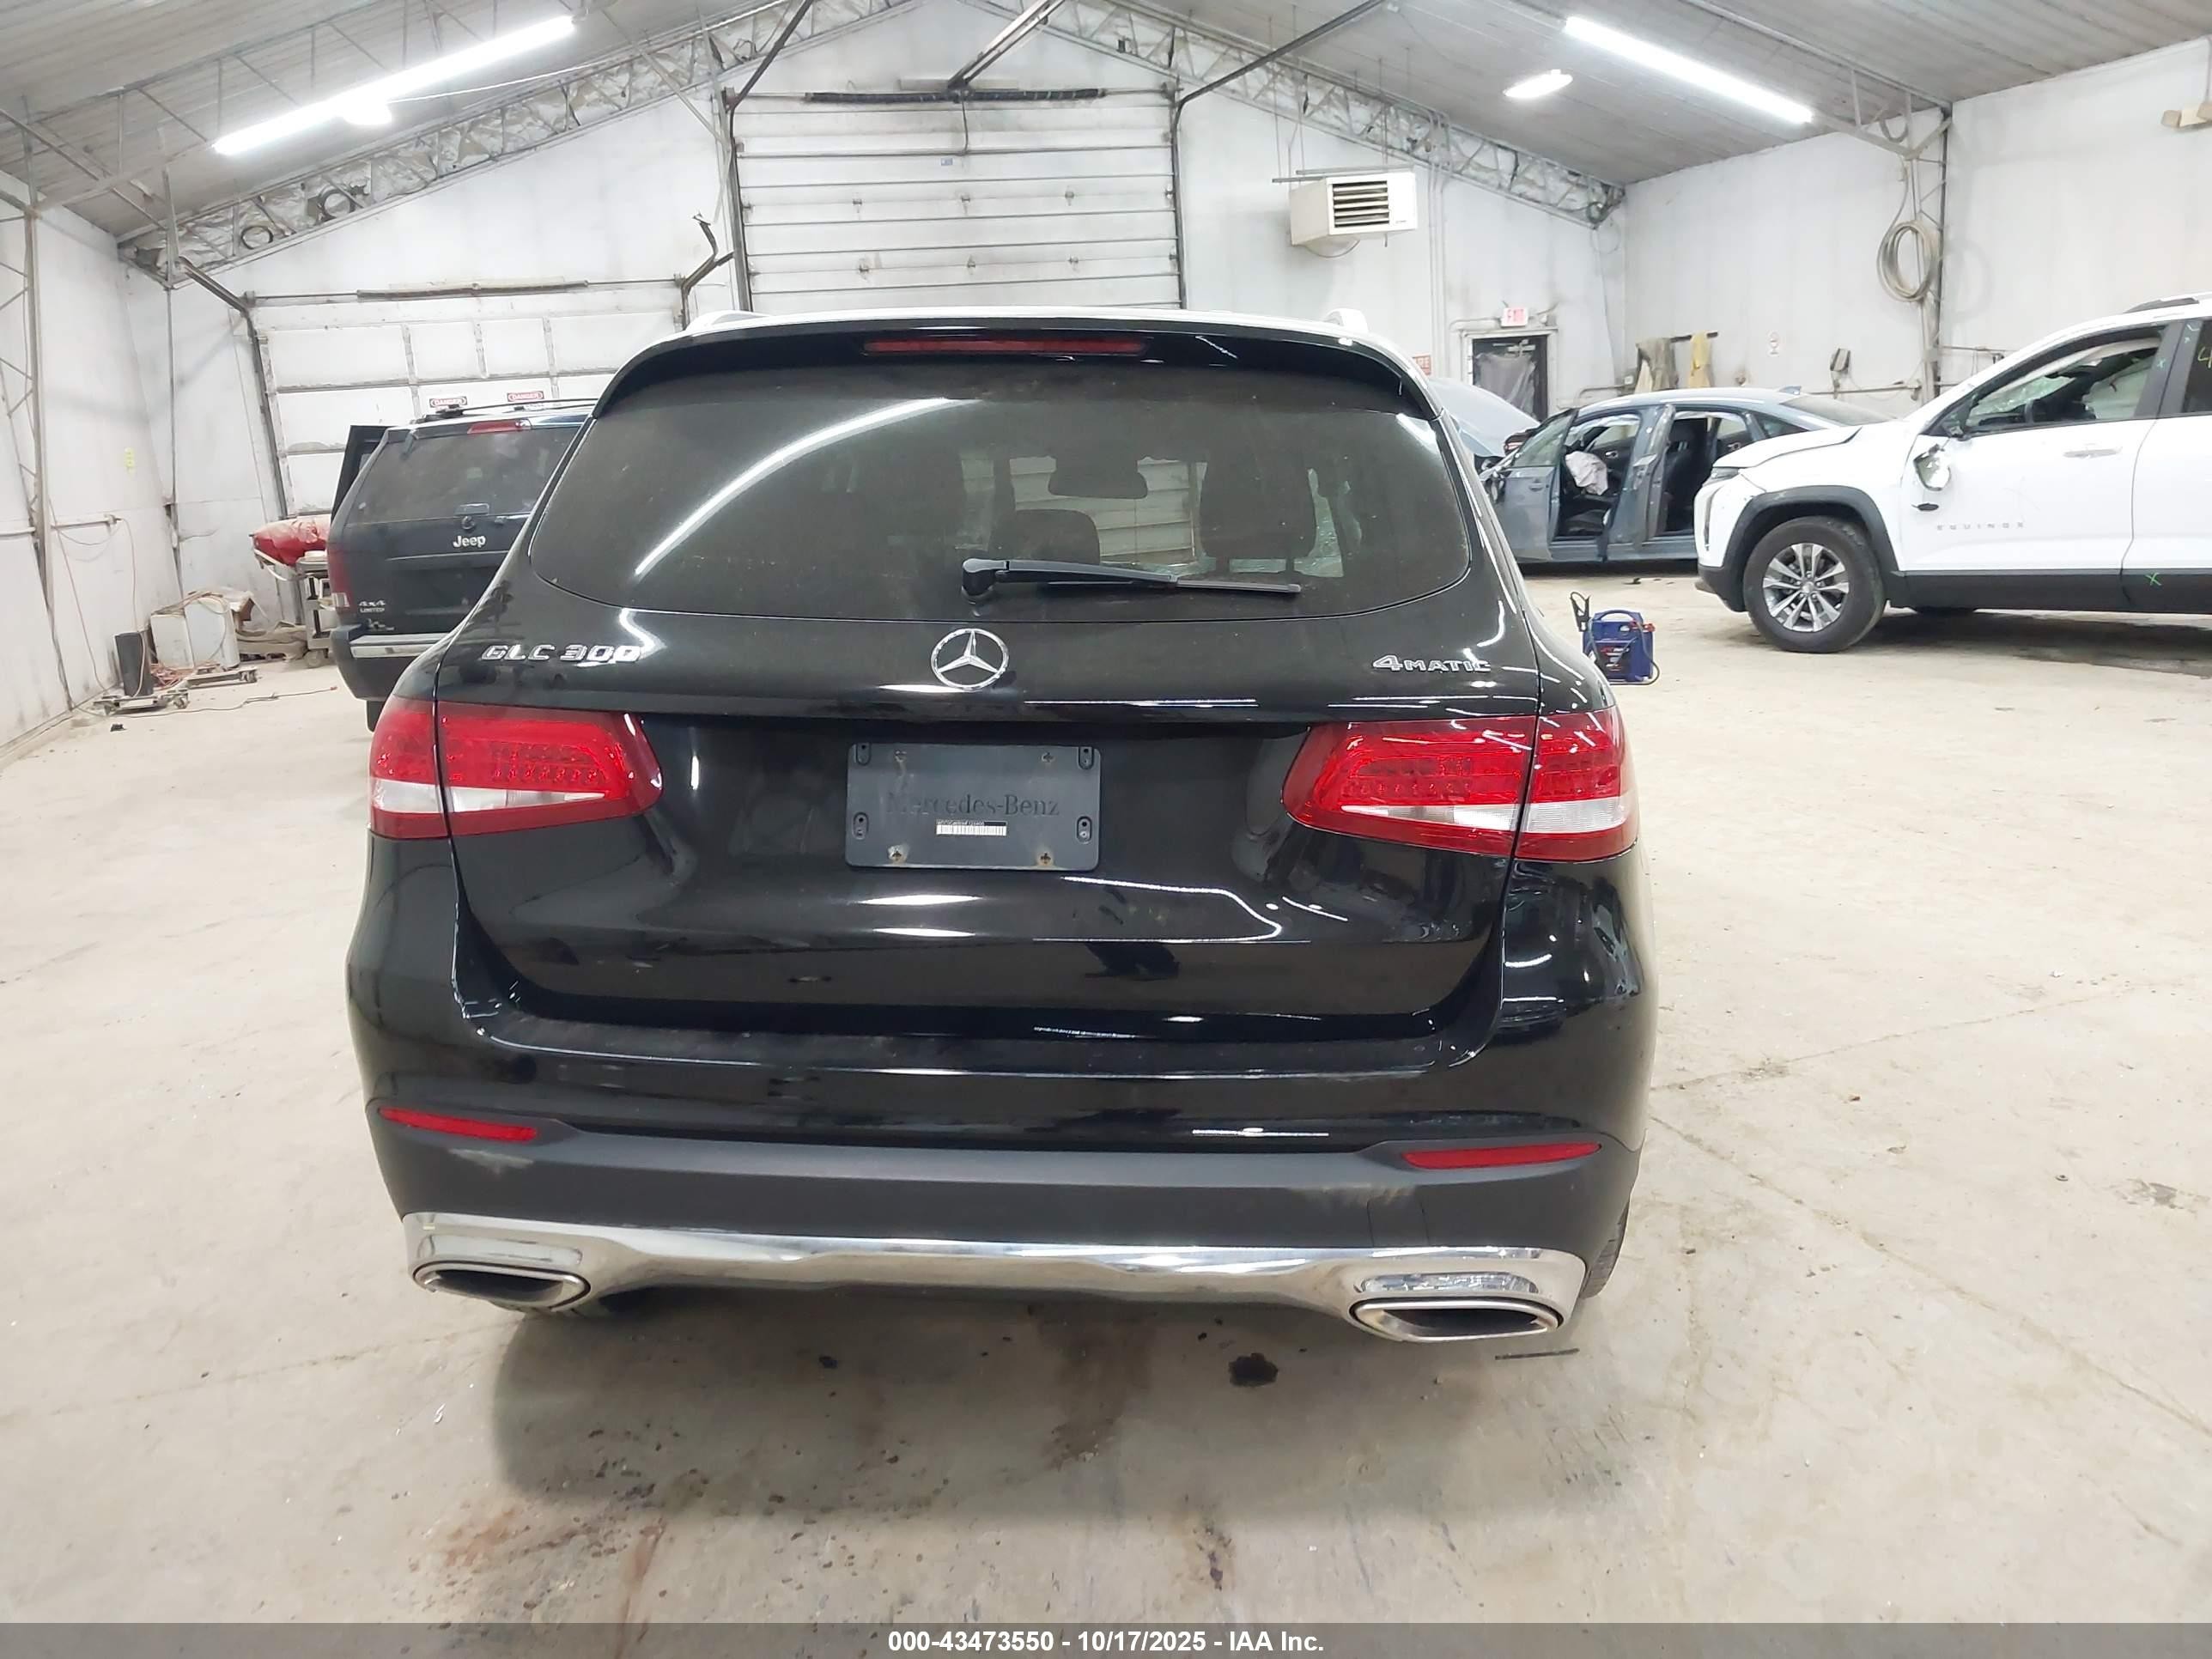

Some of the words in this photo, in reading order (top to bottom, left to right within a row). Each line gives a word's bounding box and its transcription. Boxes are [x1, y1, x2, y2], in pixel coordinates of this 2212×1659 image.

[434, 398, 463, 407] DANGER
[512, 392, 540, 400] DANGER
[1937, 522, 2024, 532] EQUINOX
[453, 535, 486, 548] Jeep
[481, 645, 556, 661] GLC
[560, 645, 641, 663] 300
[1373, 654, 1492, 672] 4MATIC
[886, 793, 1060, 816] Mercedes-Benz
